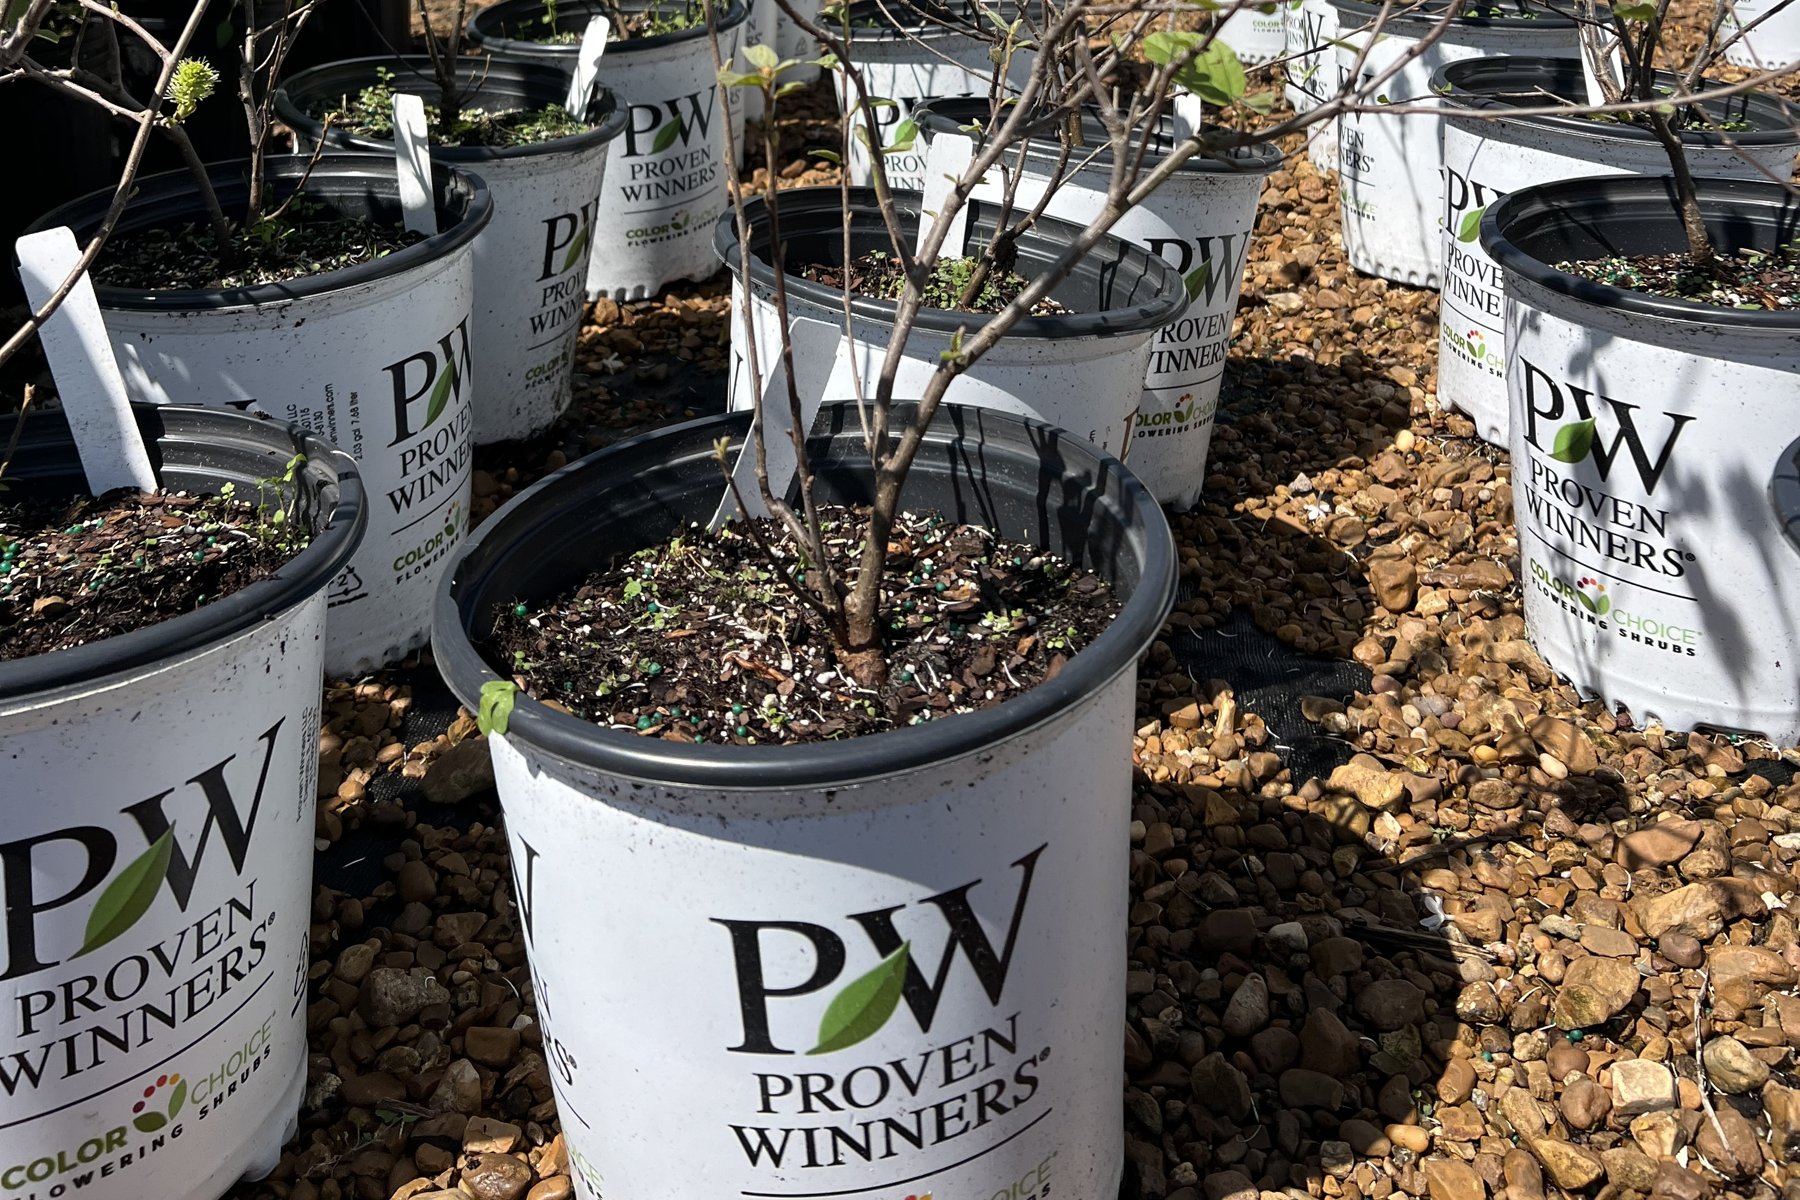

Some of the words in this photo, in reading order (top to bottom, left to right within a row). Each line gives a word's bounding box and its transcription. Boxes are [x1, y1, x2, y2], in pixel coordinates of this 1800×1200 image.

[620, 84, 717, 158] PW
[630, 145, 711, 181] PROVEN
[626, 223, 669, 239] COLOR
[1444, 265, 1503, 320] WINNE
[1448, 242, 1503, 290] PROVE
[1158, 311, 1230, 344] ROVEN
[1443, 322, 1465, 350] COLOR
[382, 313, 472, 448] PW
[1146, 337, 1228, 374] INNERS
[351, 428, 364, 442] gal
[1519, 355, 1697, 496] PW
[1531, 455, 1669, 538] PROVEN
[393, 532, 443, 571] COLOR
[1530, 557, 1575, 601] COLOR
[1532, 576, 1608, 630] FLOWERING
[1613, 609, 1697, 645] CHOICE
[1619, 628, 1696, 657] SHRUBS
[0, 716, 286, 982] PW
[14, 878, 258, 1038] PROVEN
[708, 842, 1048, 1056] PW
[191, 1020, 272, 1104] CHOICE
[199, 1043, 271, 1120] SHRUBS
[752, 1012, 1018, 1114] PROVEN
[1, 1125, 128, 1190] COLOR
